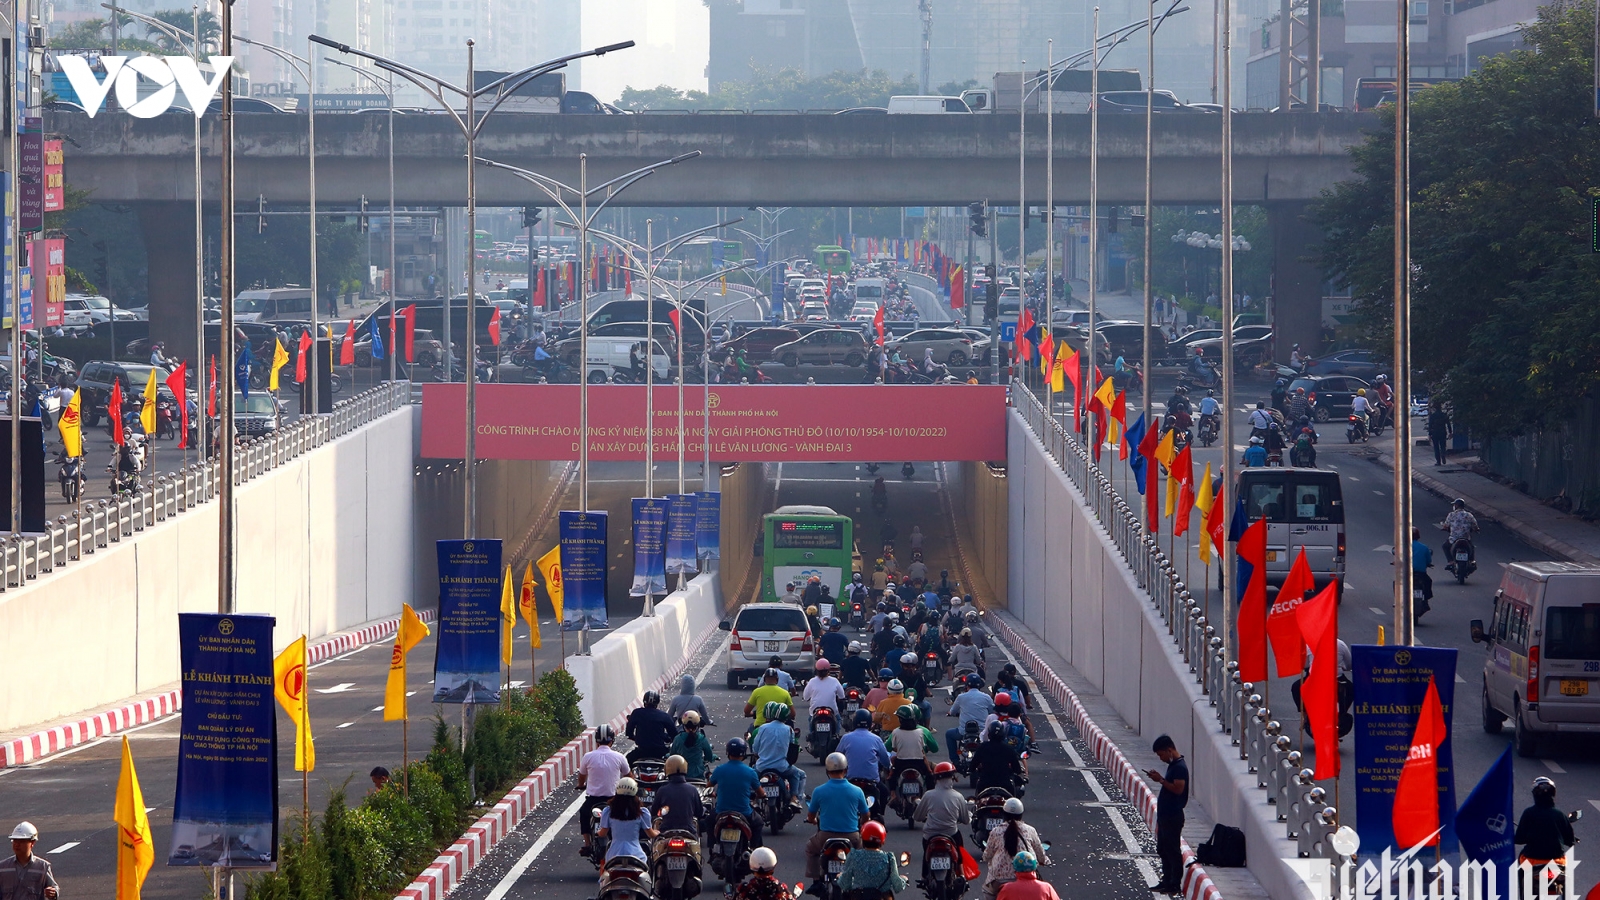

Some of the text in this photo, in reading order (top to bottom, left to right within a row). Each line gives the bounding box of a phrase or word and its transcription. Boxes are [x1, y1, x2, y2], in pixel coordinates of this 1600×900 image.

[22, 164, 41, 174] nhập
[27, 187, 36, 195] và
[22, 199, 40, 208] vùng
[738, 408, 752, 416] PHỐ
[754, 409, 764, 417] HÀ
[766, 409, 778, 418] NỘI
[477, 424, 507, 435] CÔNG
[509, 425, 539, 436] TRÌNH
[542, 425, 571, 436] CHÀO
[608, 426, 621, 436] KỶ
[624, 426, 648, 438] NIỆM
[651, 428, 663, 437] 68
[722, 425, 742, 436] GIẢI
[745, 426, 782, 437] PHÓNG
[784, 424, 804, 437] THỦ
[807, 426, 823, 437] ĐÔ
[825, 427, 947, 438] (10/10/1954-10/10/2022)
[590, 441, 605, 452] ÁN
[607, 442, 626, 452] XÂY
[716, 442, 726, 452] LÊ
[728, 442, 749, 452] VĂN
[751, 442, 787, 452] LƯƠNG
[796, 442, 824, 452] VÀNH
[826, 443, 844, 452] ĐAI
[846, 443, 852, 452] 3
[184, 669, 272, 685] LỄ KHÁNH THÀNH
[1356, 702, 1369, 714] LỄ
[1372, 703, 1410, 714] KHÁNH
[1480, 842, 1503, 852] VĨNH
